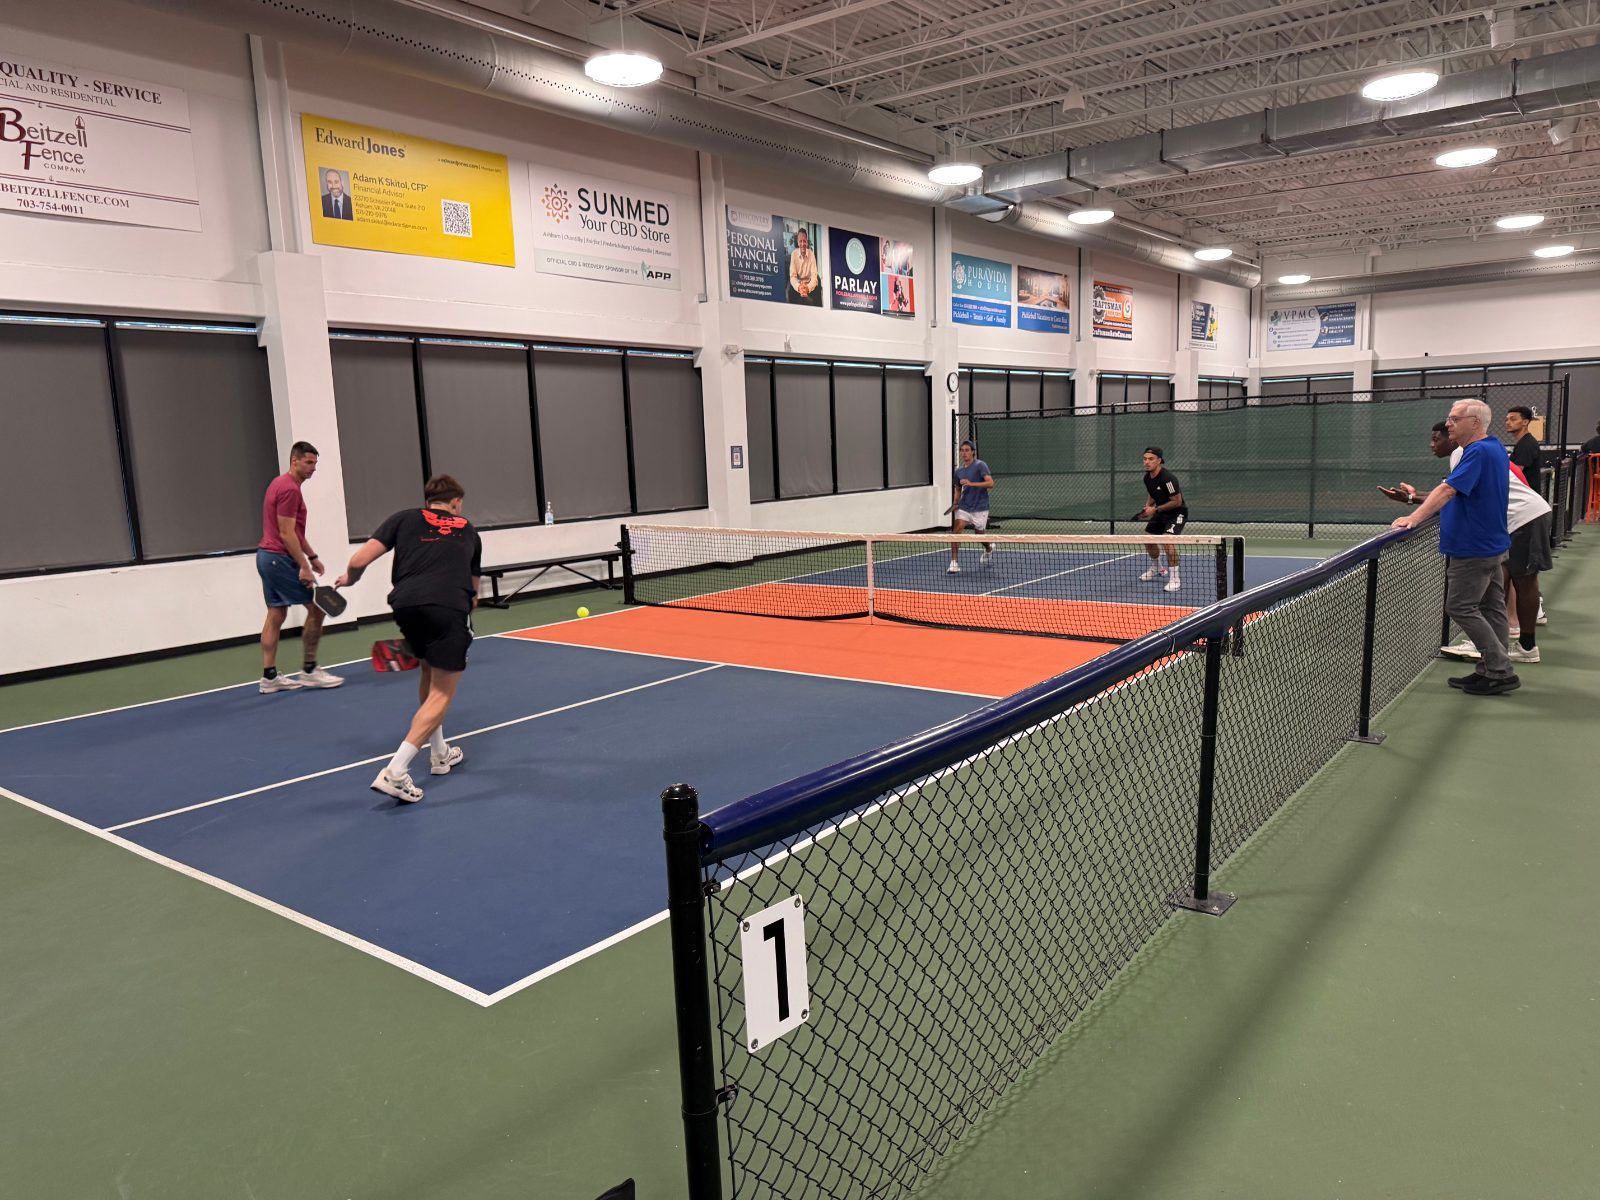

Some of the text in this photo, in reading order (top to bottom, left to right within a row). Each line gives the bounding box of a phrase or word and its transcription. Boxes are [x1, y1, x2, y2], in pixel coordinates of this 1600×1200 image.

[0, 61, 79, 88] QUALITY
[93, 80, 162, 105] SERVICE
[25, 83, 48, 94] AND
[50, 87, 117, 107] RESIDENTIAL
[0, 107, 88, 148] Beitzell
[315, 127, 406, 158] Edward Jones
[19, 140, 84, 170] Fence
[43, 163, 87, 174] COMPANY
[353, 172, 377, 184] Adam
[378, 177, 384, 185] K
[385, 177, 410, 191] Skitol,
[353, 183, 405, 198] Financial Advisor
[17, 198, 84, 215] 703-754-0011
[577, 187, 669, 226] SUNMED
[579, 213, 670, 244] Your CBD Store
[728, 245, 778, 265] INANCIAL
[582, 262, 604, 270] RECOVERY
[605, 265, 624, 273] SPONSOR
[646, 270, 672, 280] APP
[731, 258, 779, 273] LANNING
[834, 275, 877, 294] PARLAY
[1284, 308, 1315, 320] VPMC
[763, 917, 790, 1023] 1
